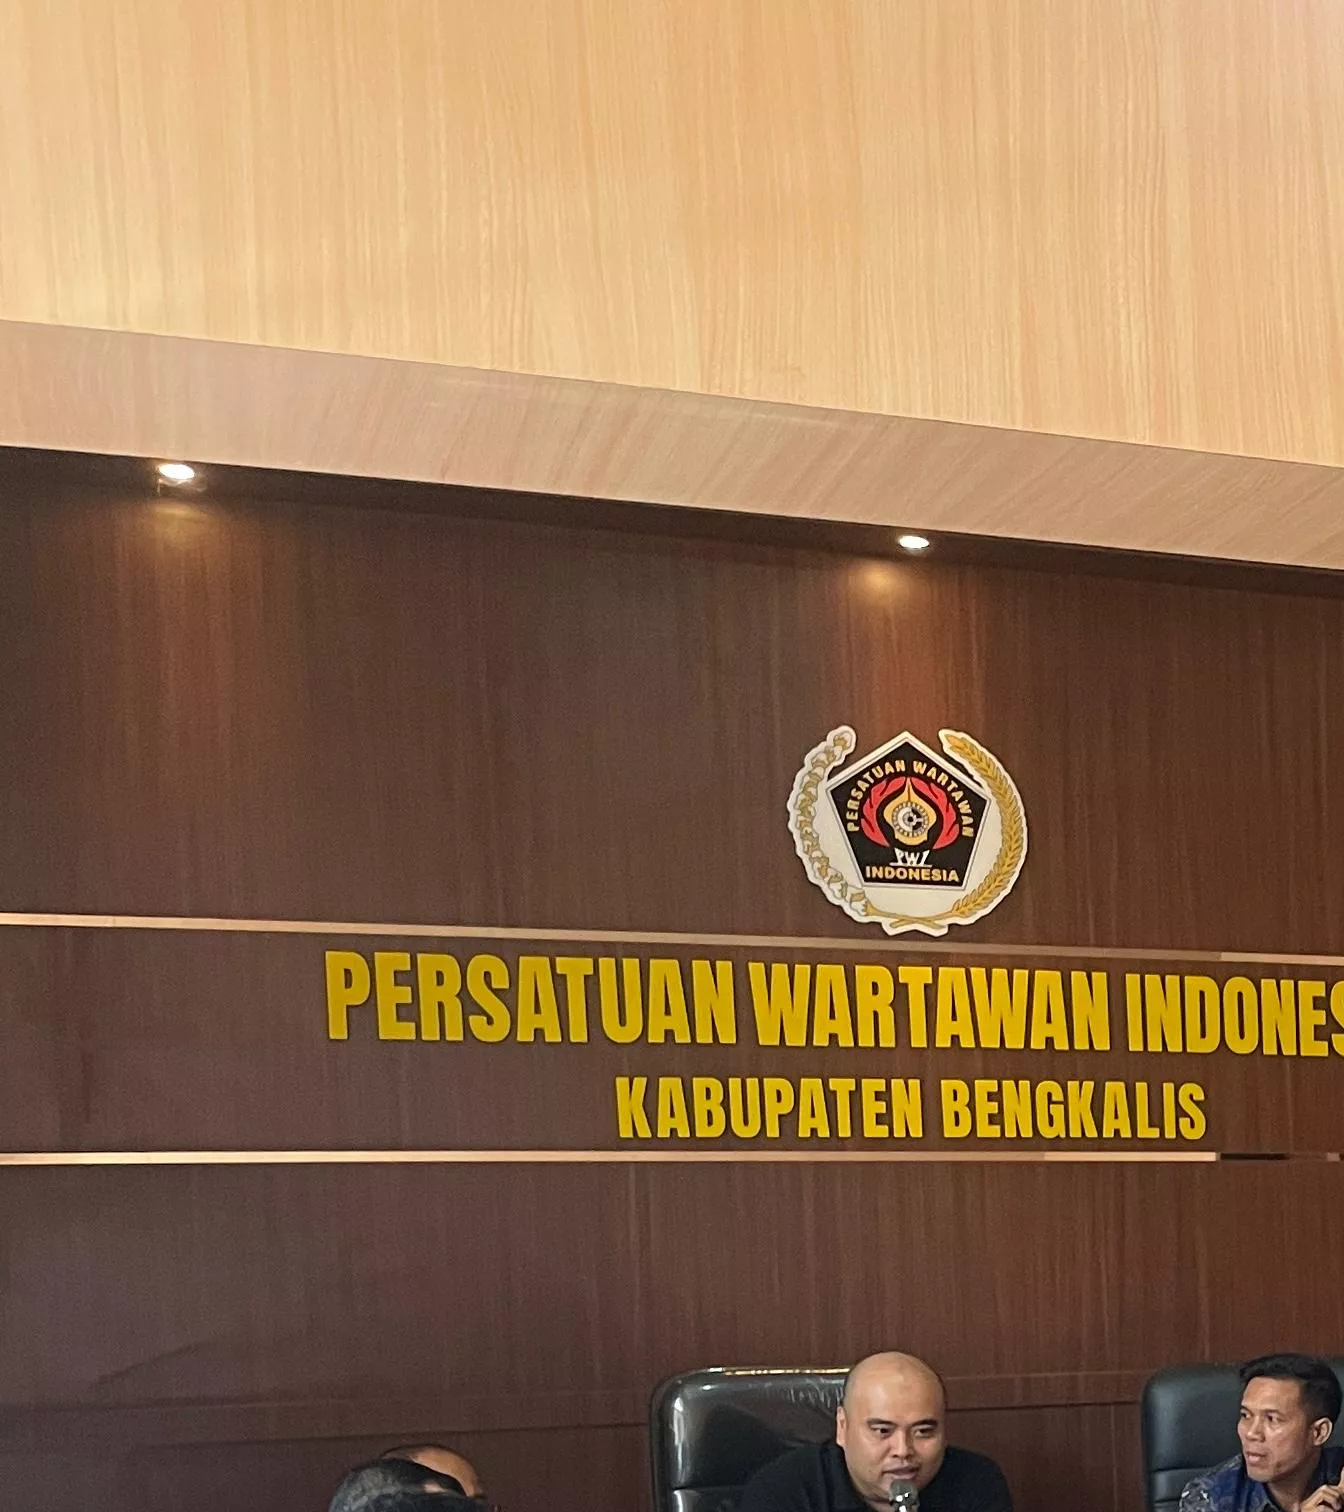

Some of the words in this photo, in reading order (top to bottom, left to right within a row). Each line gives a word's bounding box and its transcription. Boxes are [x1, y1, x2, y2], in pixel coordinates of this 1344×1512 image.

[847, 760, 905, 832] PERSATUAN
[913, 760, 976, 838] WARTAWAN
[866, 866, 959, 882] INDONESIA
[326, 951, 736, 1044] PERSATUAN
[748, 962, 1110, 1050] WARTAWAN
[616, 1077, 922, 1138] KABUPATEN
[941, 1079, 1206, 1139] BENGKALIS
